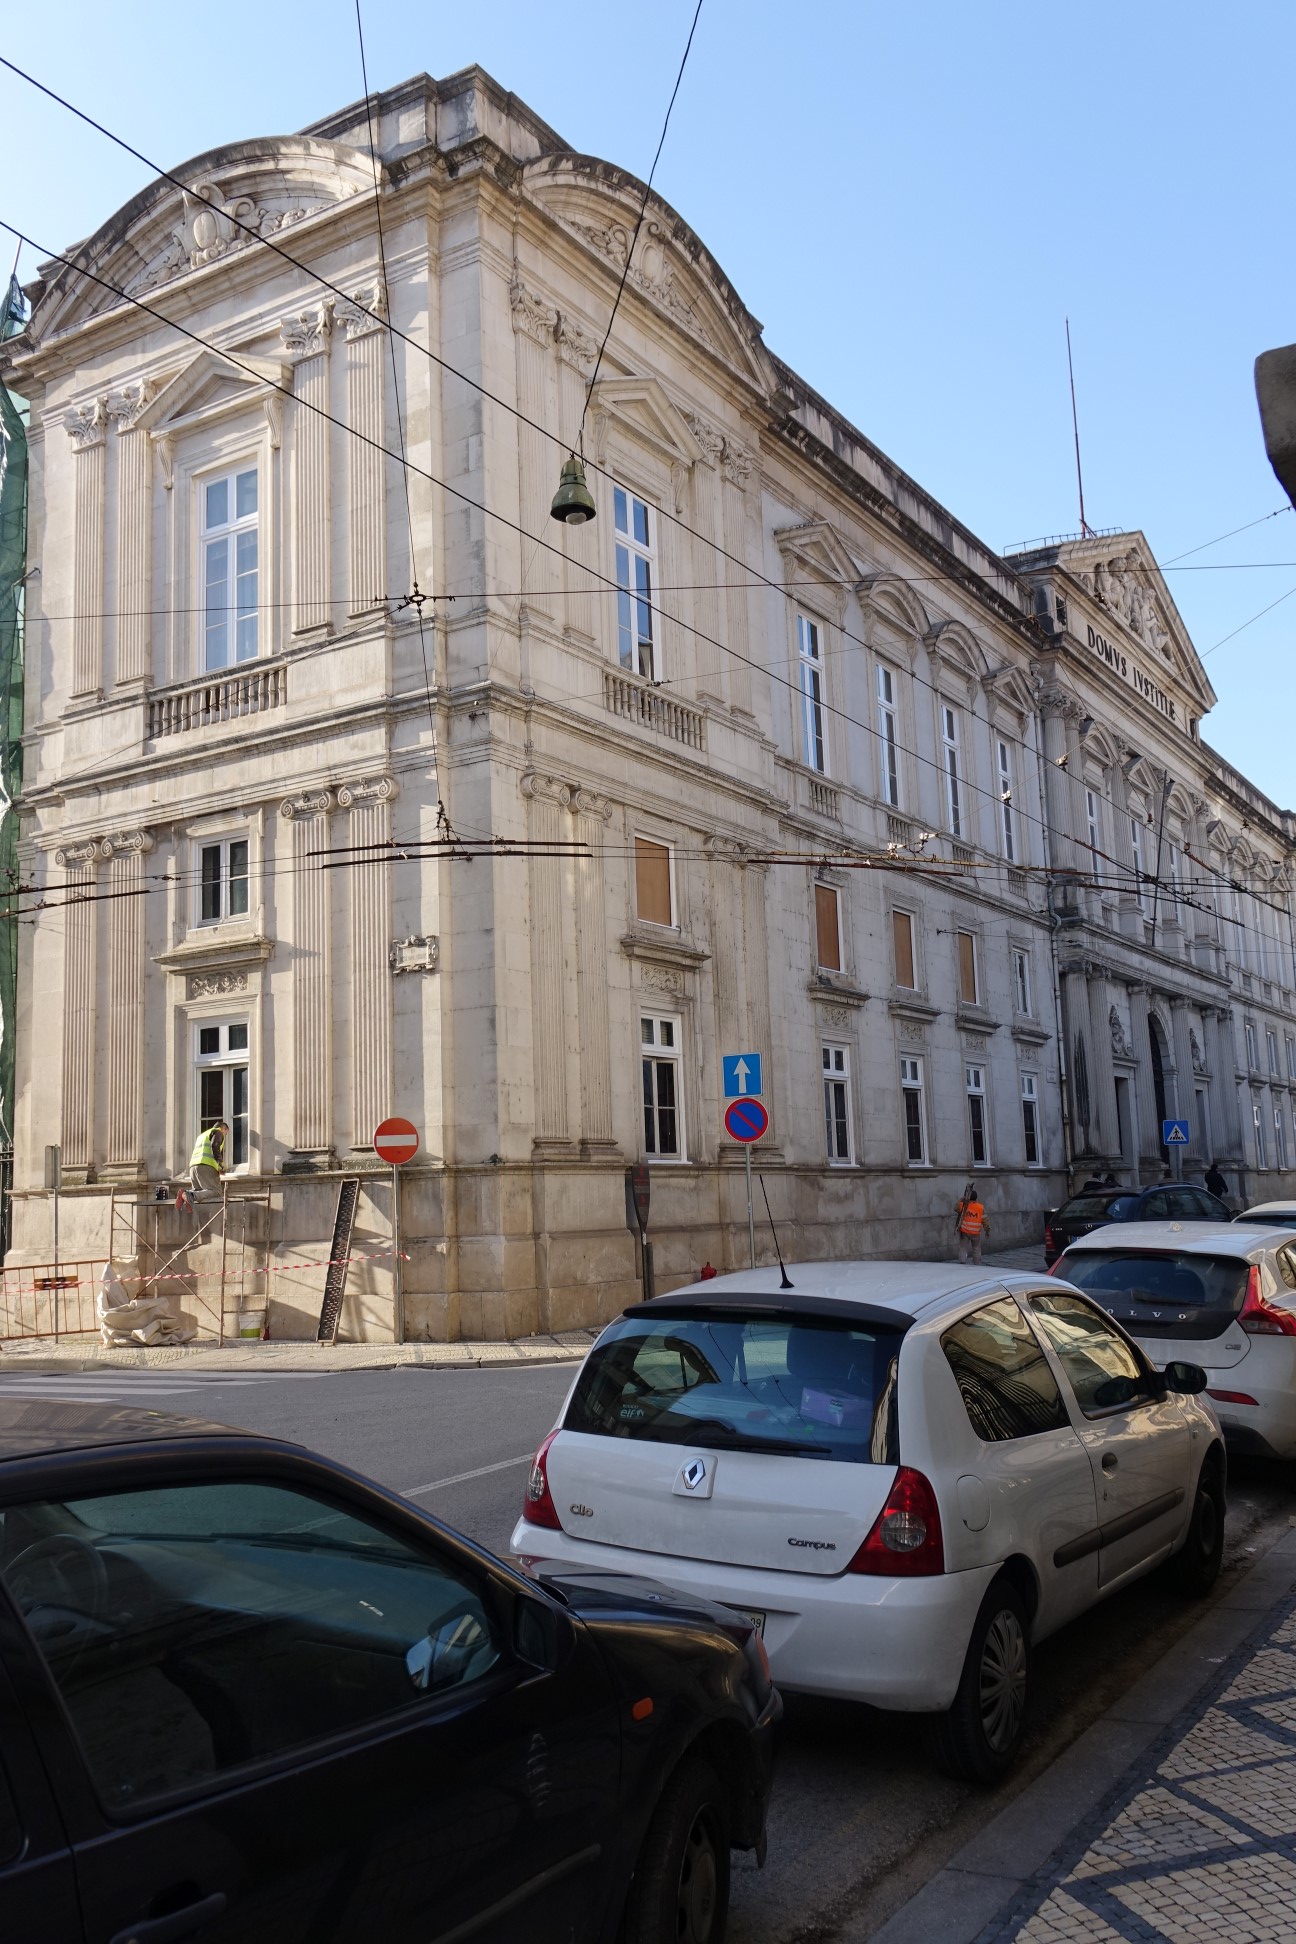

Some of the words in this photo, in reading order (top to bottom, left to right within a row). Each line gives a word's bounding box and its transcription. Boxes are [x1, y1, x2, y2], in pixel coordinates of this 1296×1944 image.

[1087, 624, 1127, 677] DOMVS
[620, 1409, 636, 1418] elf
[787, 1537, 837, 1551] Campus
